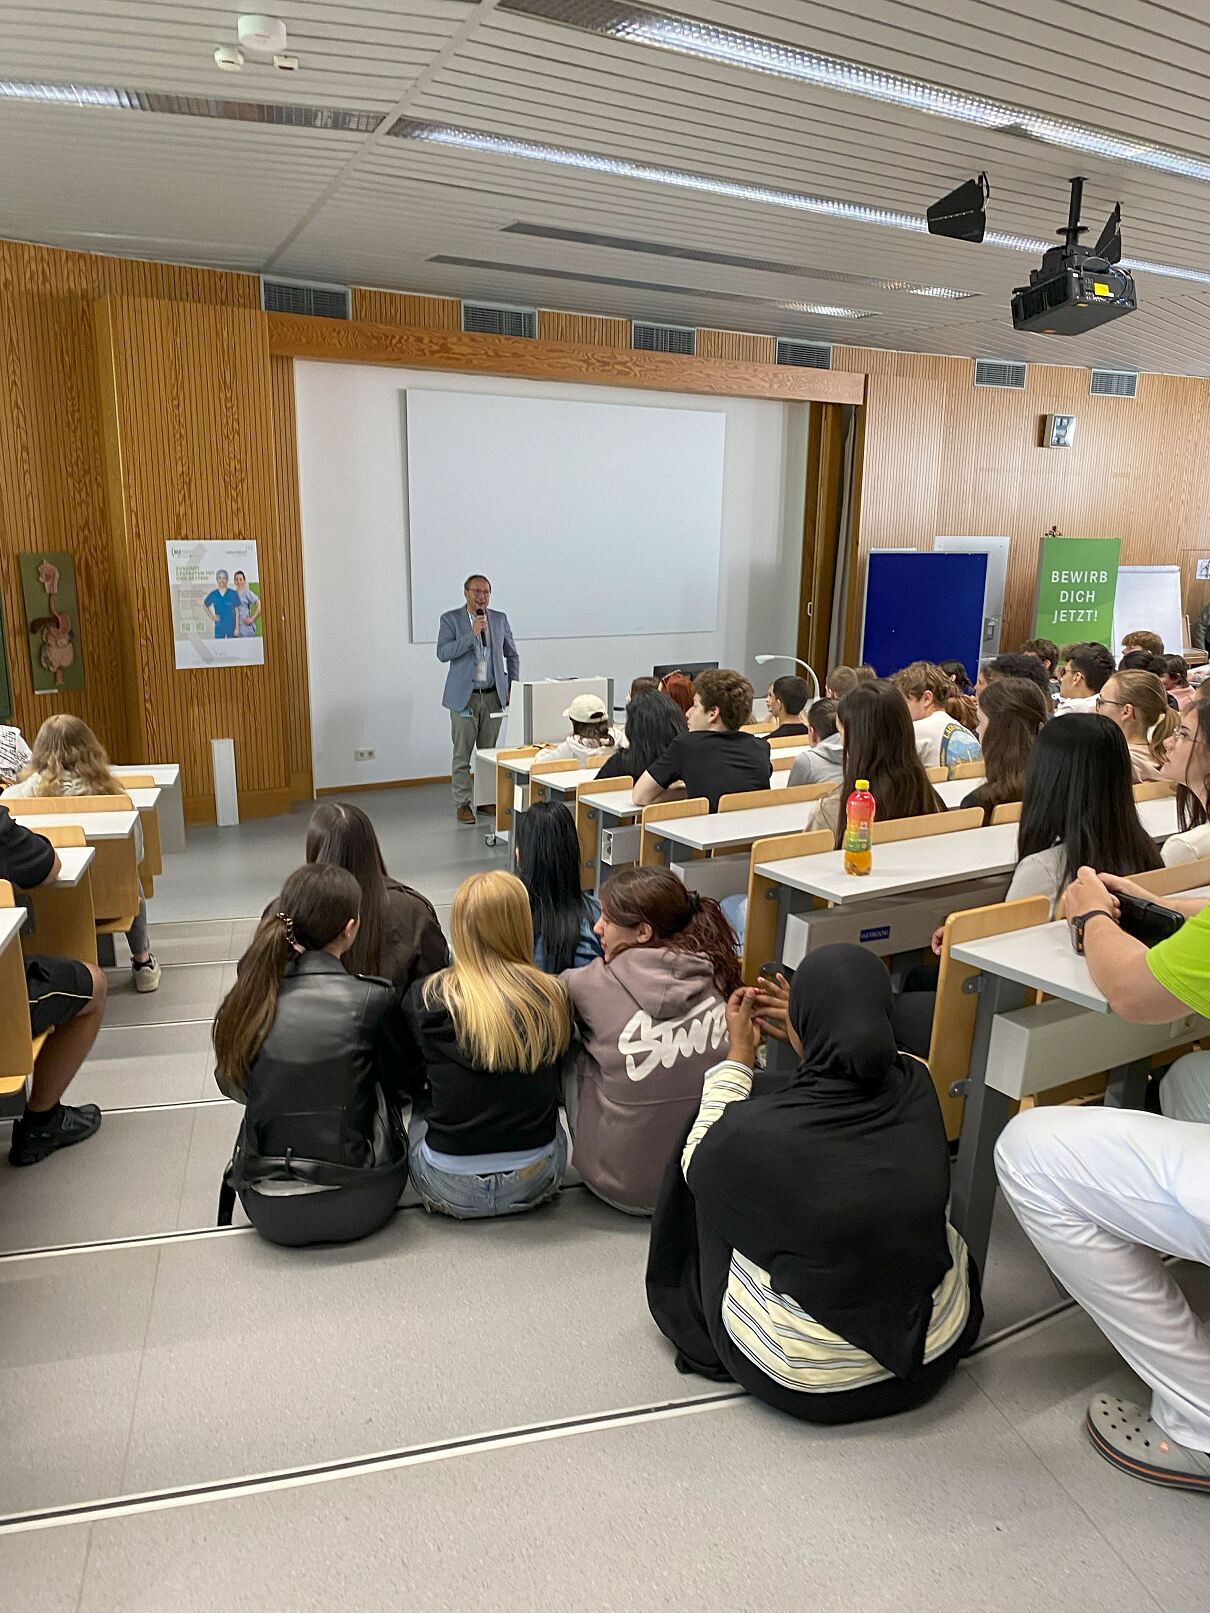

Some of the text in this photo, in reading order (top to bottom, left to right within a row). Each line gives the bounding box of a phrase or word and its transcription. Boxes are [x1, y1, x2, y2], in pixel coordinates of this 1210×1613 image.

[1051, 570, 1108, 584] BEWIRB
[1059, 590, 1096, 603] DICH
[1052, 609, 1098, 624] JETZT!
